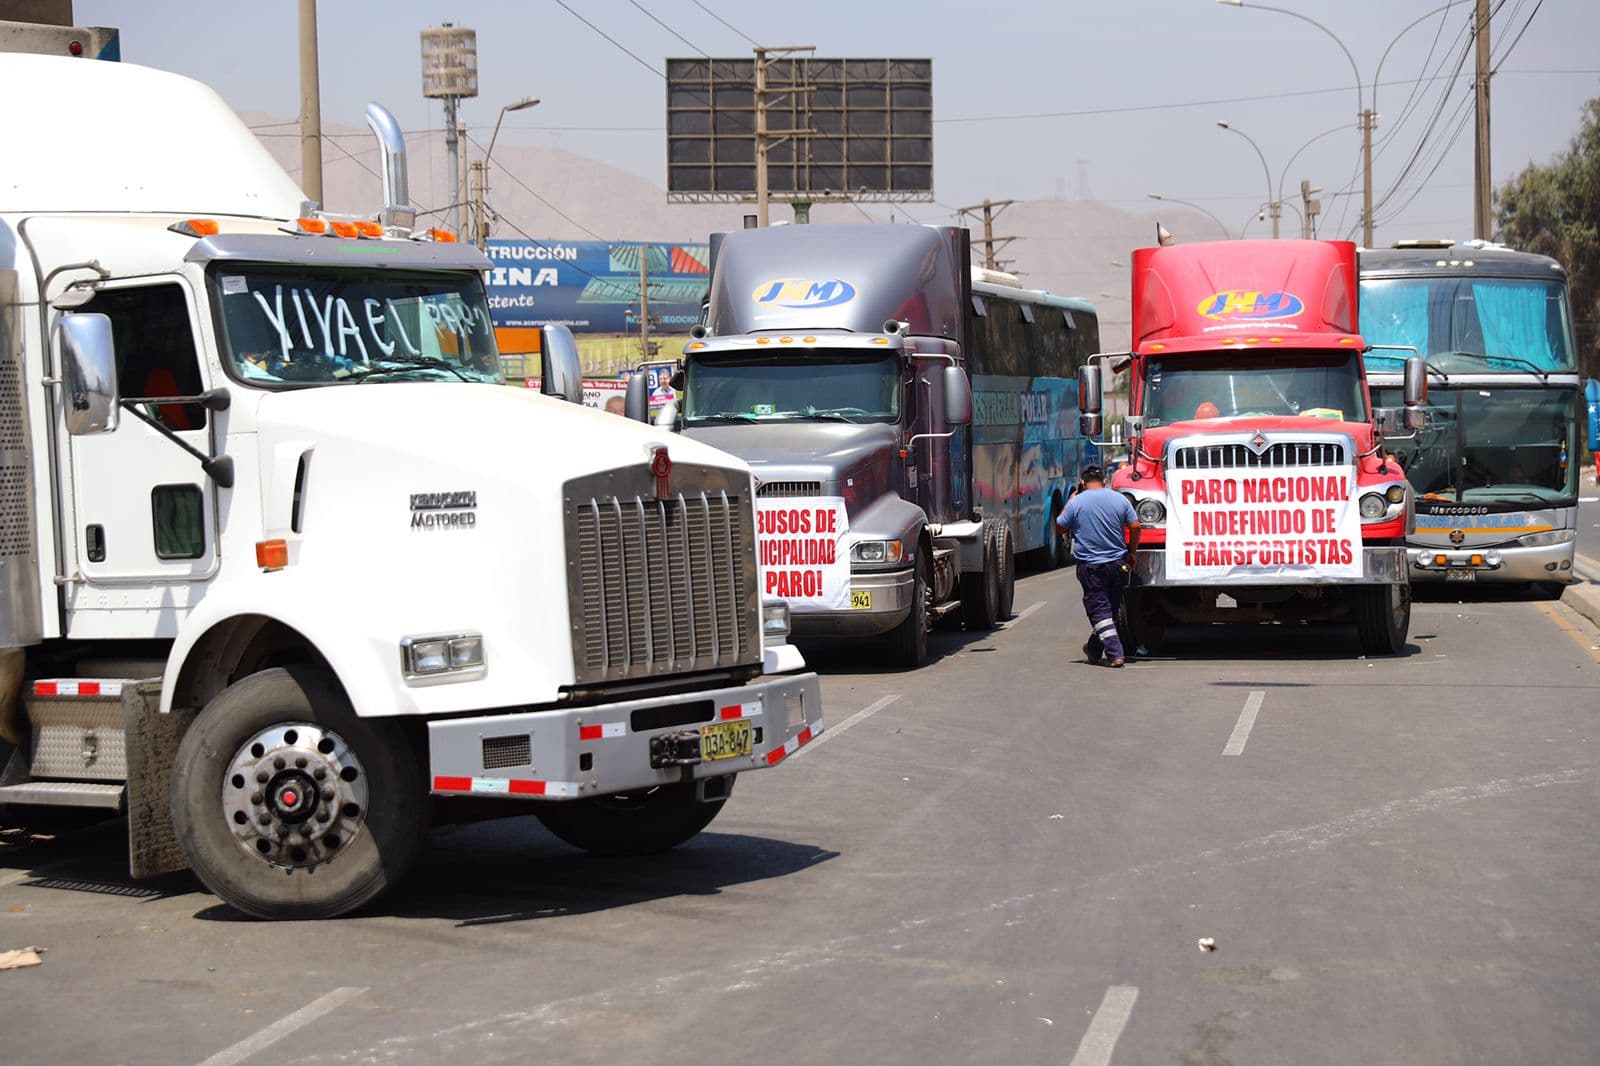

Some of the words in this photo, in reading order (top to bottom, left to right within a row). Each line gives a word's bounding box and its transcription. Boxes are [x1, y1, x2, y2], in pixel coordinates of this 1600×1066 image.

[1021, 393, 1048, 423] POLAR
[1182, 478, 1237, 504] PARO
[1243, 476, 1349, 503] NACIONAL
[411, 512, 475, 527] MOTORED
[815, 509, 836, 533] DE
[1193, 509, 1306, 536] INDEFINIDO
[1311, 508, 1336, 533] DE
[1183, 539, 1353, 566] TRANSPORTISTAS
[766, 570, 823, 597] PARO!
